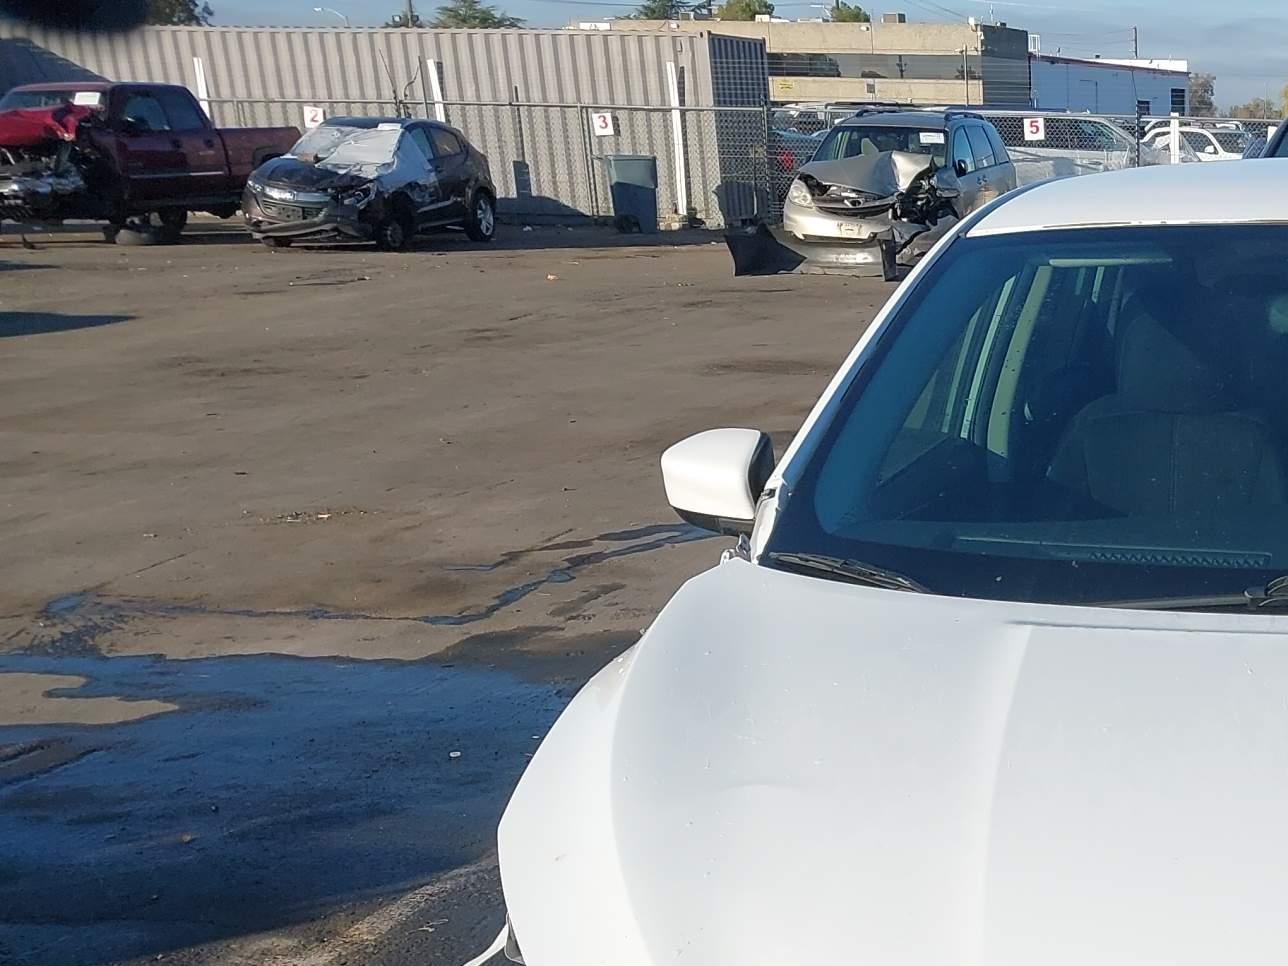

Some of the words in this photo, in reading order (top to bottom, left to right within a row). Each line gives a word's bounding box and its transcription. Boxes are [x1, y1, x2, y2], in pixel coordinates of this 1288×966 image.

[310, 109, 319, 123] 2
[598, 115, 608, 129] 3
[1030, 120, 1040, 134] 5
